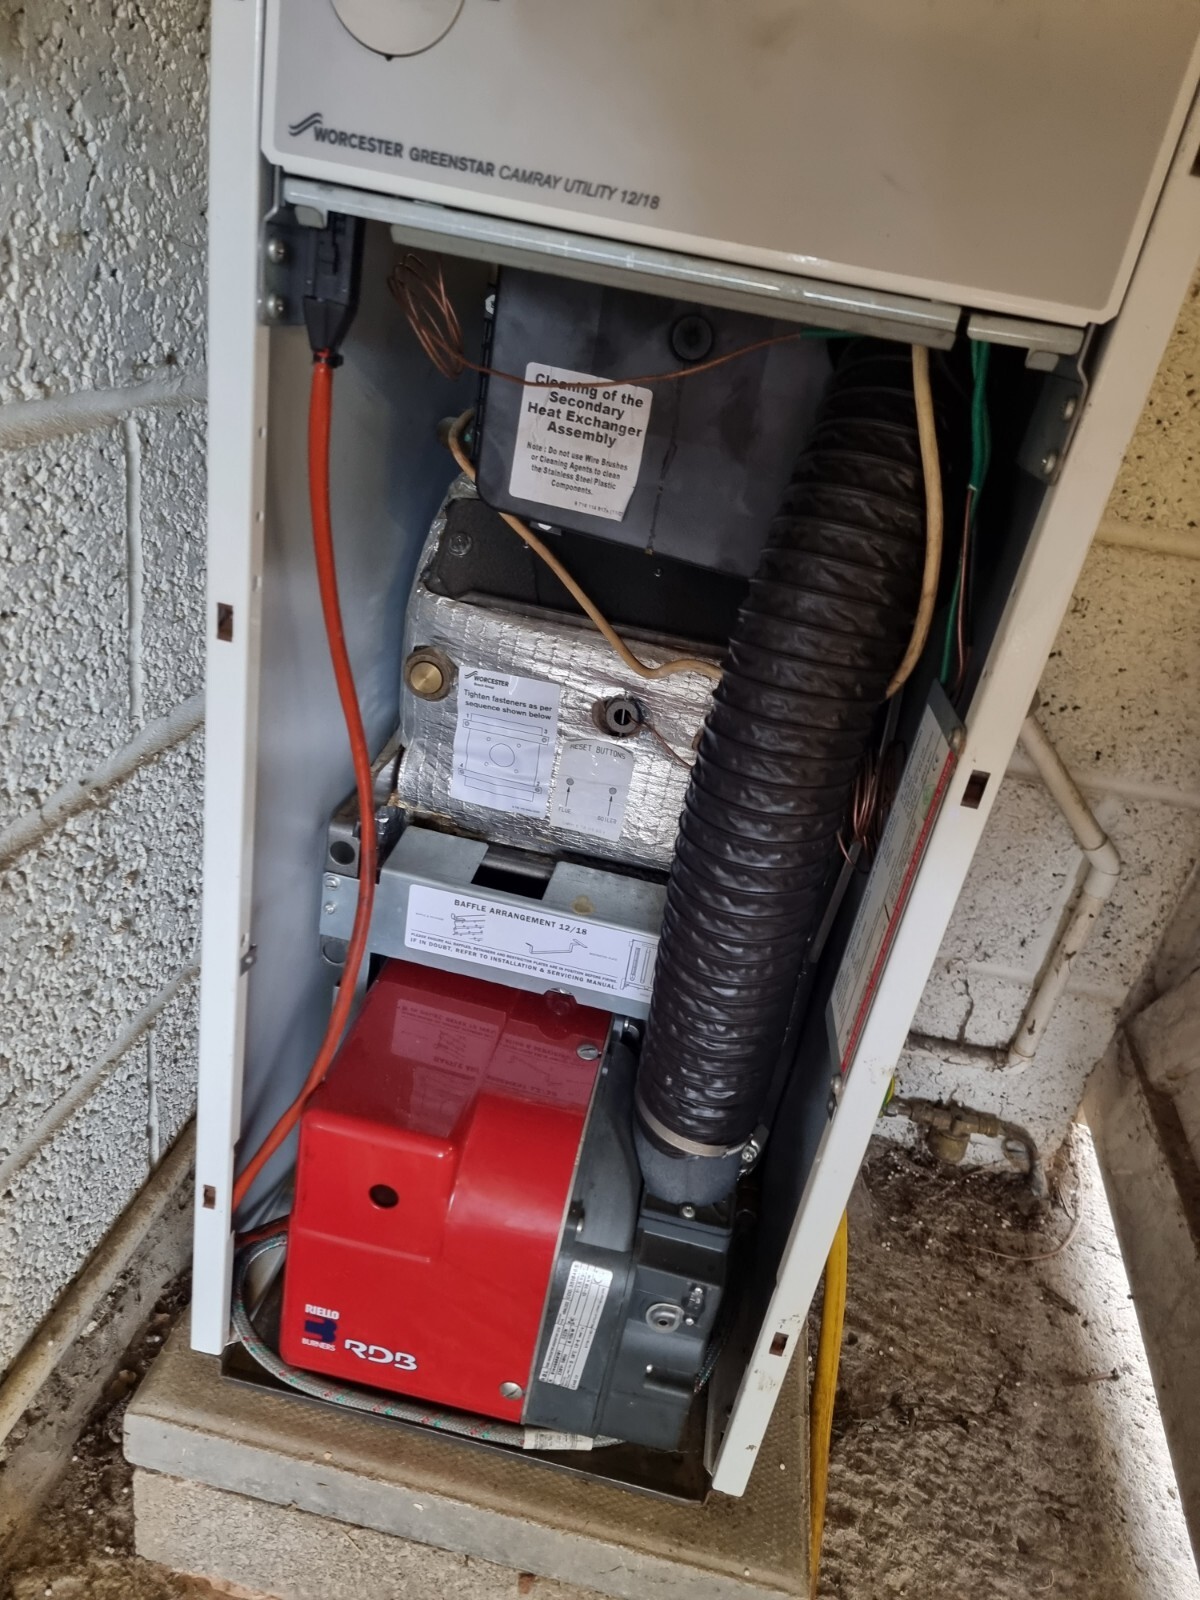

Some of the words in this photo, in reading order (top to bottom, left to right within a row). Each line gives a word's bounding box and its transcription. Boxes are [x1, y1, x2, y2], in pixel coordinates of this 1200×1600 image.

[314, 126, 403, 158] WORCESTER
[409, 147, 495, 177] GREENSTAR
[499, 165, 562, 189] CAMRAY
[564, 178, 617, 201] UTILITY
[620, 190, 660, 209] 12/18
[549, 391, 624, 420] Secondary
[602, 390, 617, 402] of
[621, 393, 643, 408] the
[527, 401, 561, 419] Heat
[566, 410, 642, 437] Exchanger
[547, 421, 616, 448] Assembly
[539, 455, 568, 469] Cleaning
[569, 462, 592, 474] Agents
[594, 467, 601, 476] to
[602, 470, 620, 480] clean
[548, 446, 557, 455] Do
[559, 448, 570, 458] not
[571, 452, 583, 461] use
[585, 454, 599, 464] Wire
[601, 458, 628, 471] Brushes
[531, 464, 541, 473] the
[543, 467, 574, 480] Stainless
[575, 474, 593, 484] Steel
[594, 478, 616, 490] Plastic
[474, 675, 509, 687] WORCESTER
[464, 689, 490, 701] Tighten
[492, 696, 527, 708] fasteners
[465, 700, 500, 712] sequence
[502, 707, 527, 716] shown
[529, 711, 551, 720] below
[570, 743, 592, 752] RESET
[595, 746, 626, 760] BUTTONS
[558, 806, 571, 814] FLUE
[597, 815, 616, 825] BOILER
[454, 899, 486, 913] BAFFLE
[489, 908, 556, 928] ARRANGEMENT
[558, 923, 588, 936] 12/18
[428, 942, 453, 952] DOUBT,
[455, 948, 477, 957] REFER
[490, 956, 537, 971] INSTALLATION
[547, 969, 584, 982] SERVICING
[586, 978, 618, 990] MANUAL.
[305, 1303, 340, 1320] RIELLO
[344, 1339, 418, 1371] RDB
